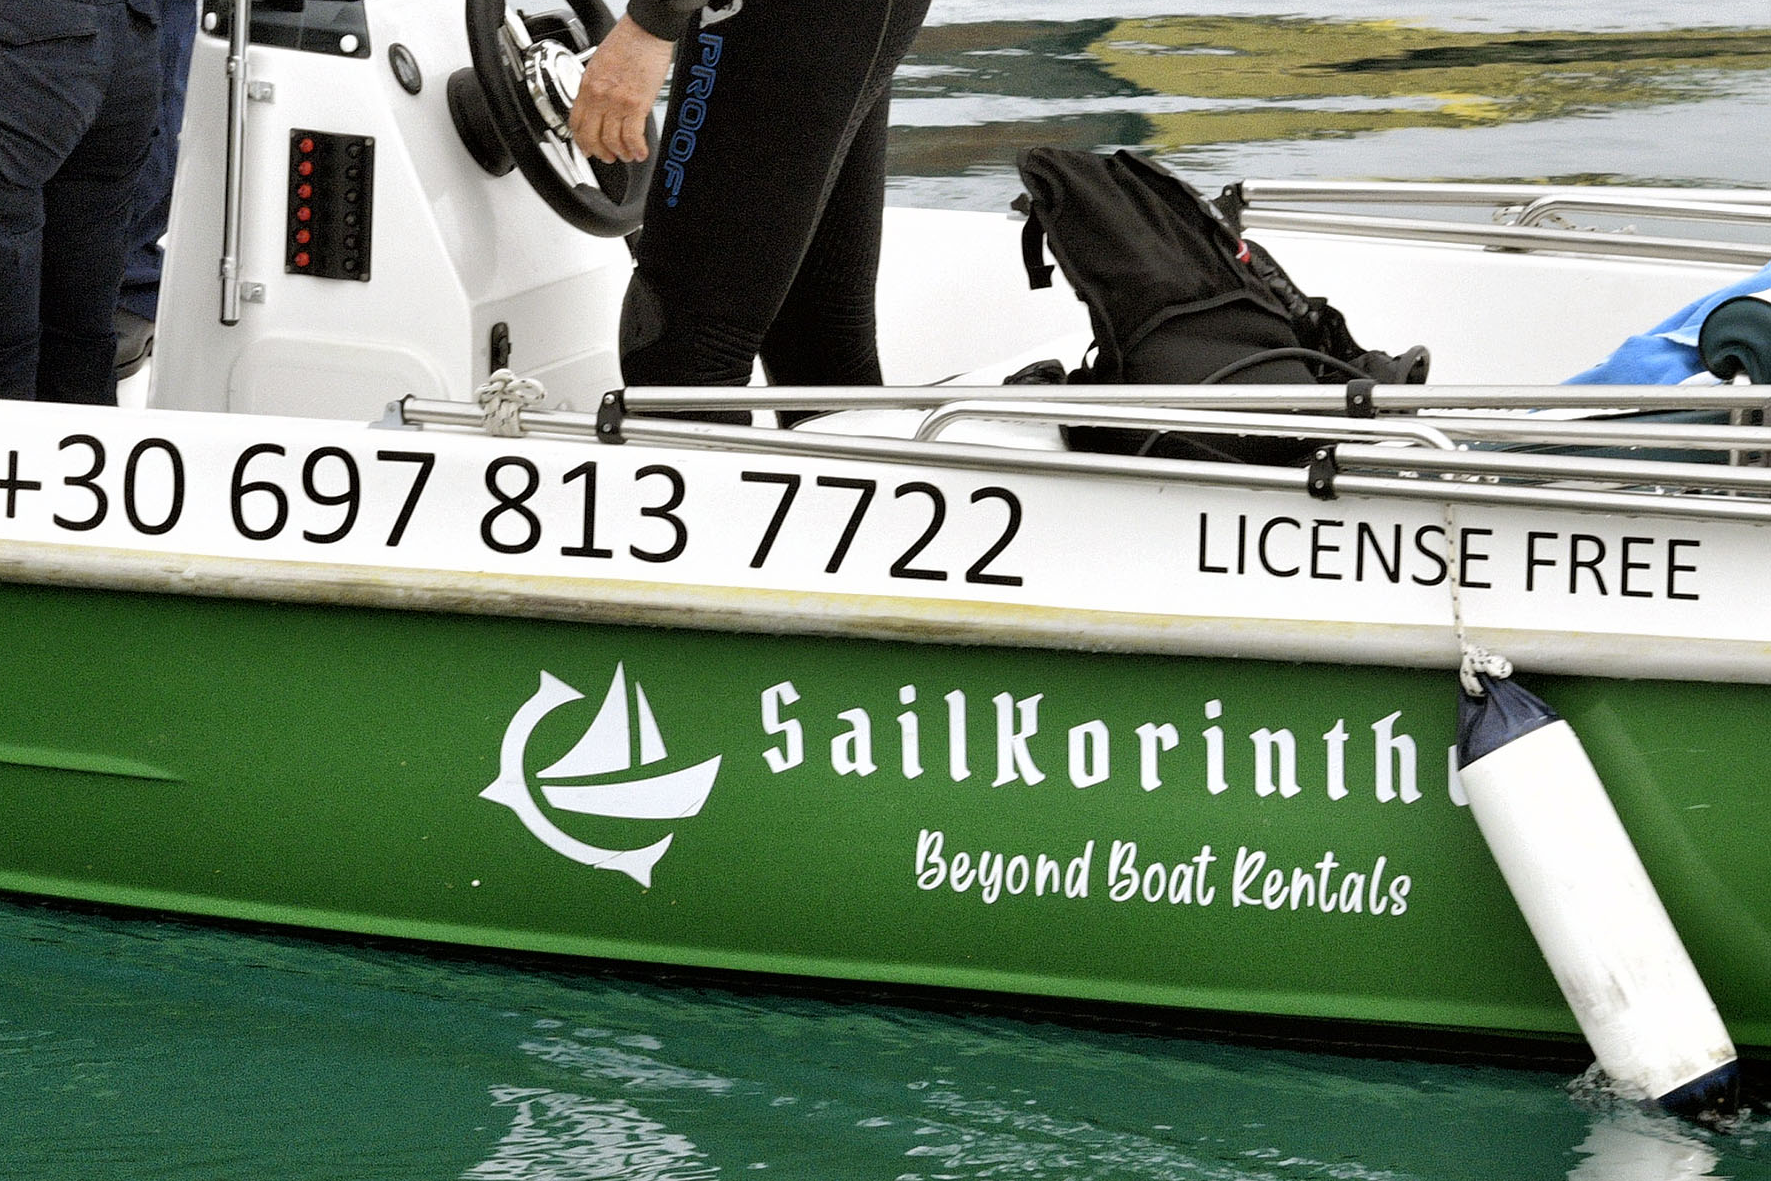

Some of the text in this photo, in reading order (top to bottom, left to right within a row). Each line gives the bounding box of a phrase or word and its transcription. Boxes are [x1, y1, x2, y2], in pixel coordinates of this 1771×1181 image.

[230, 443, 436, 547] 697
[480, 455, 688, 564] 813
[740, 470, 1023, 587] 7722
[1199, 512, 1701, 601] LICENSE FREE
[761, 680, 1470, 807] SailKorinth
[915, 828, 1412, 916] Beyond Boat Rentals
